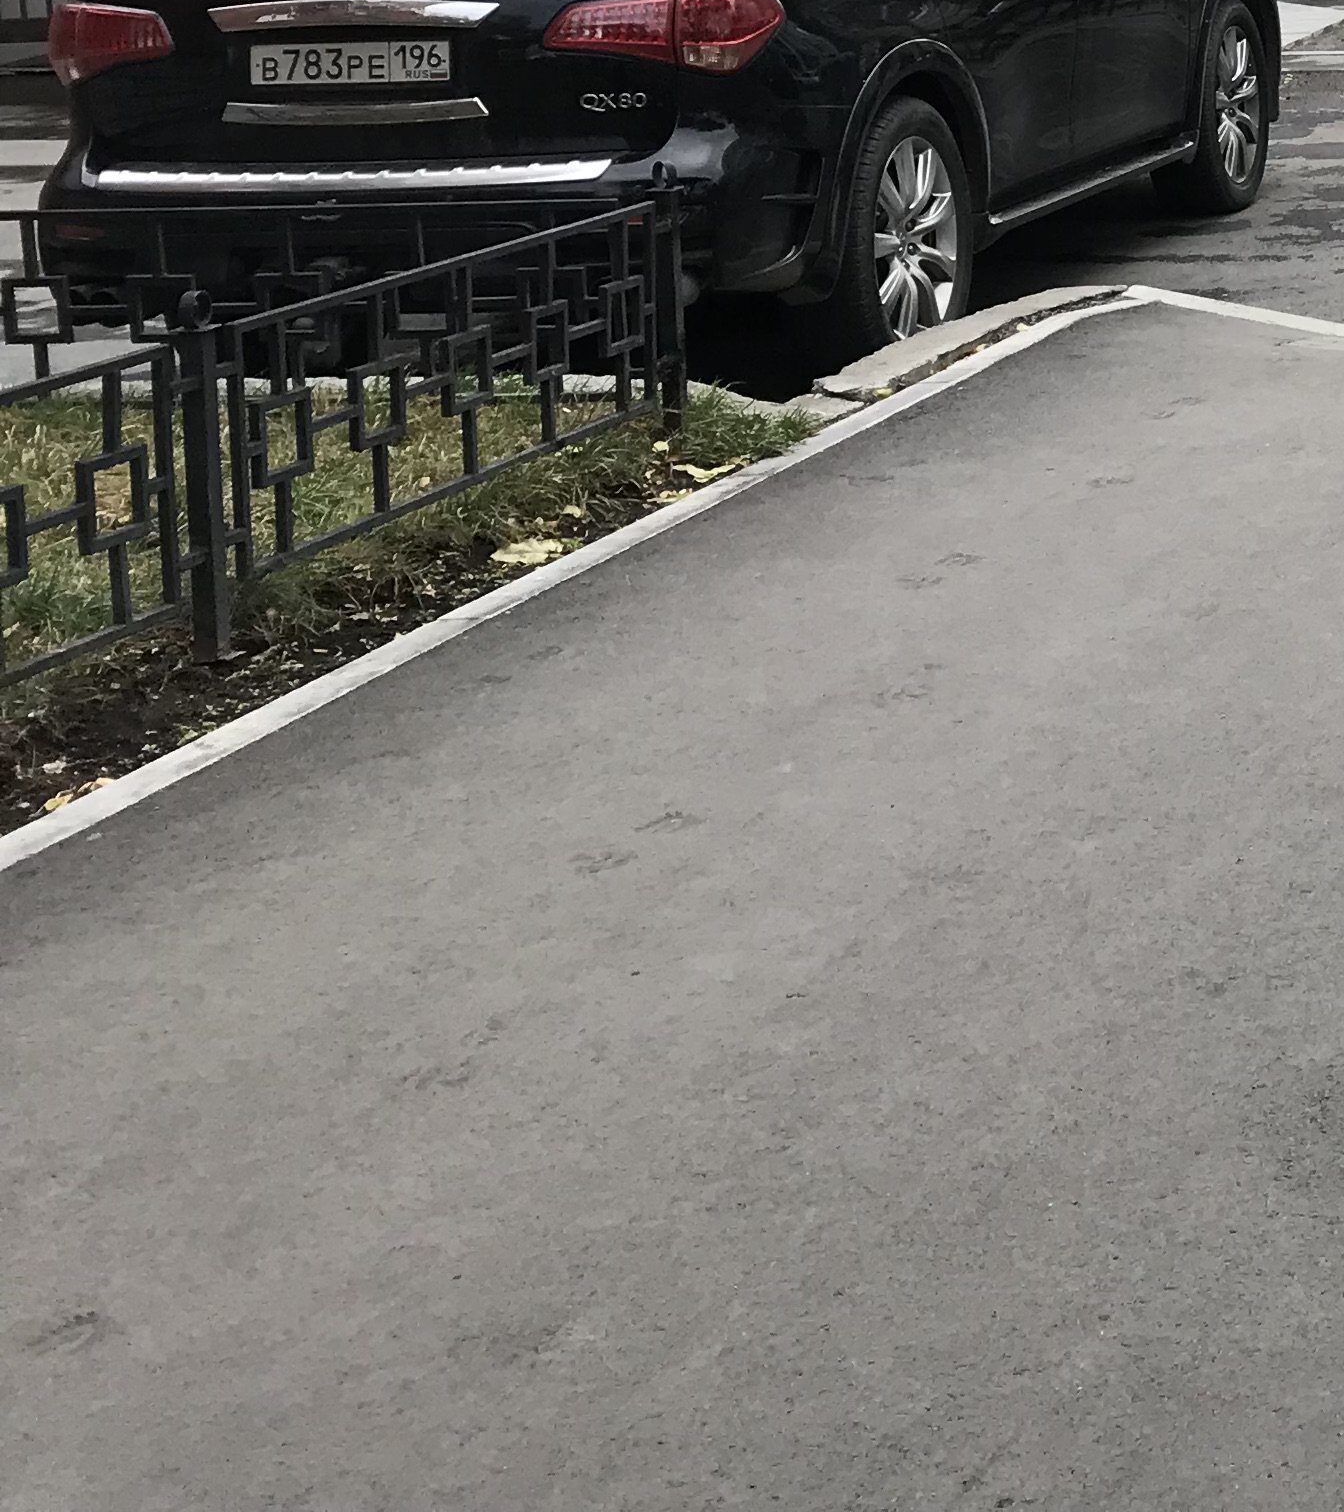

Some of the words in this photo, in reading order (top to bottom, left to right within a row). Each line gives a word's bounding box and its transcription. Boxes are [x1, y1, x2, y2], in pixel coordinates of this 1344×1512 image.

[394, 44, 441, 69] 196
[405, 70, 428, 79] RUS
[579, 90, 648, 113] QX80
